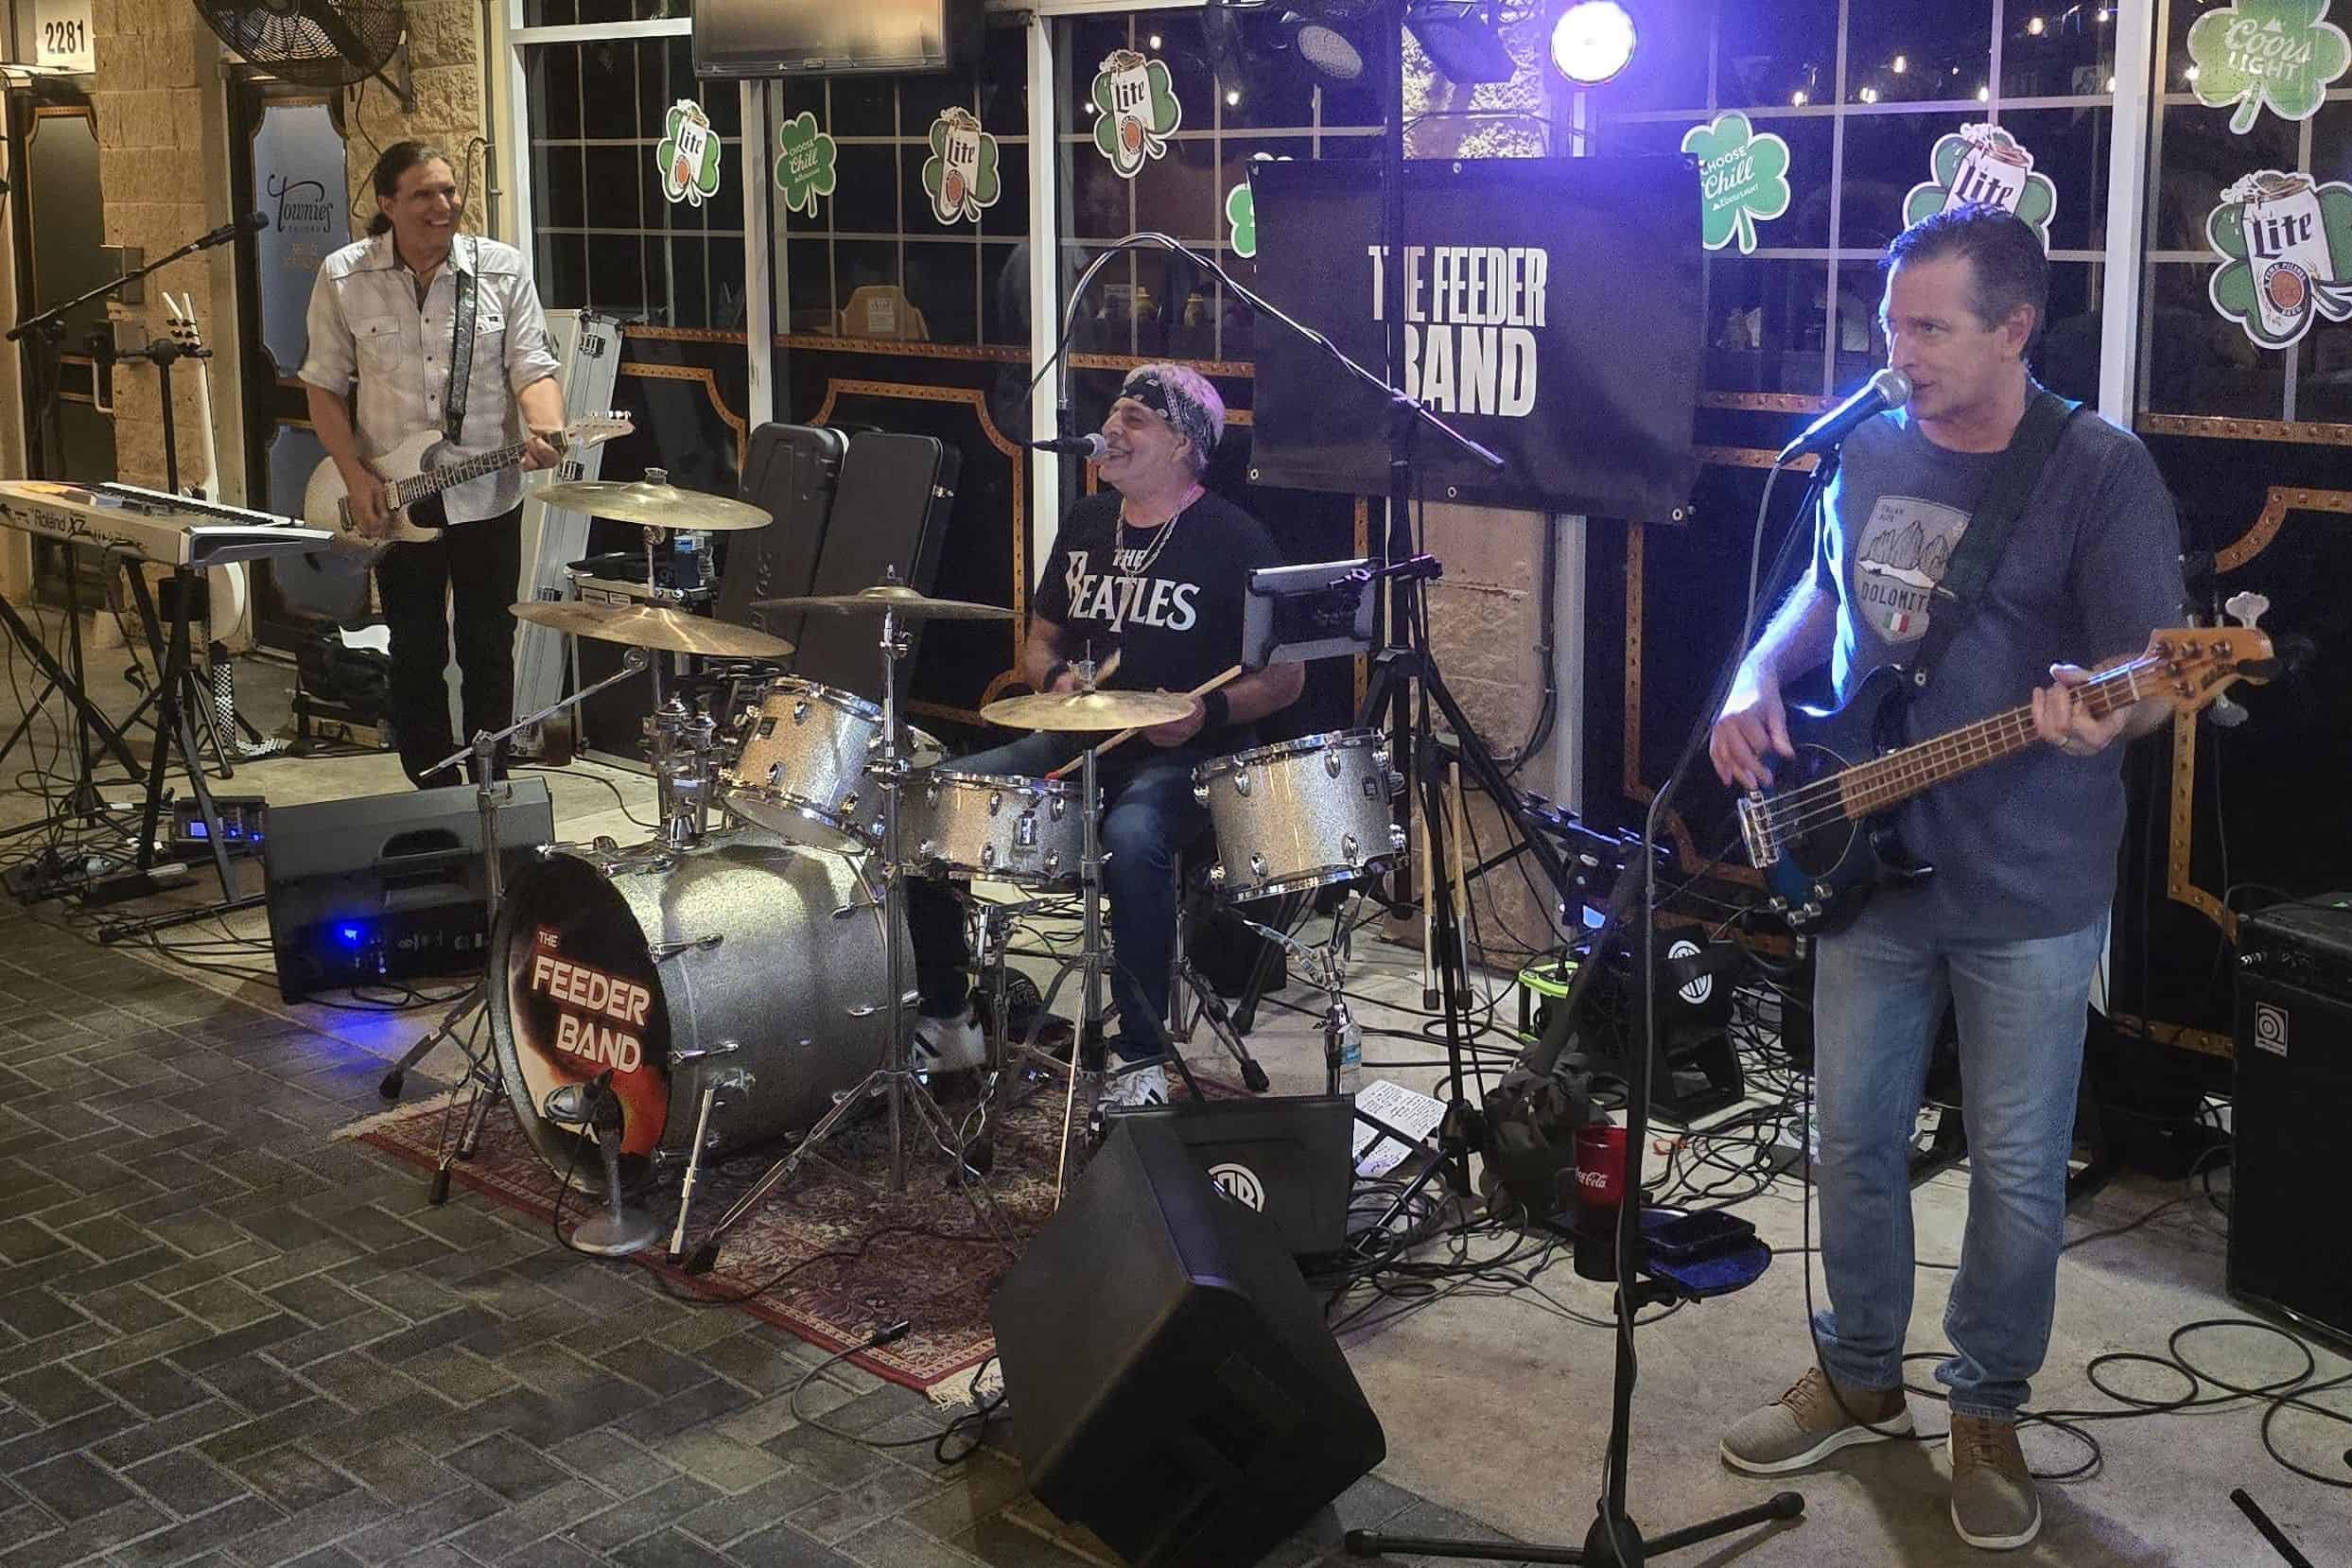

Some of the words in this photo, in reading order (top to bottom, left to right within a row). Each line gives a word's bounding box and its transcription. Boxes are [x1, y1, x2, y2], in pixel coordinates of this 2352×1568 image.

[44, 19, 85, 54] 2281
[2225, 18, 2312, 64] Coors
[2226, 51, 2300, 81] LIGHT
[1116, 79, 1145, 113] Lite
[678, 125, 703, 154] Lite
[789, 148, 819, 175] Chill
[947, 137, 976, 167] Lite
[1701, 156, 1756, 200] Chill
[1955, 163, 2014, 208] Lite
[2252, 211, 2313, 260] Lite
[1368, 245, 1426, 322] TE
[1432, 246, 1548, 327] FEEDER
[1386, 322, 1538, 418] BAND
[1065, 550, 1201, 634] BEATLES
[1861, 581, 1931, 614] DOLOMIT
[538, 930, 560, 949] THE
[531, 953, 652, 1027] FEEDER
[556, 1012, 642, 1074] BAND
